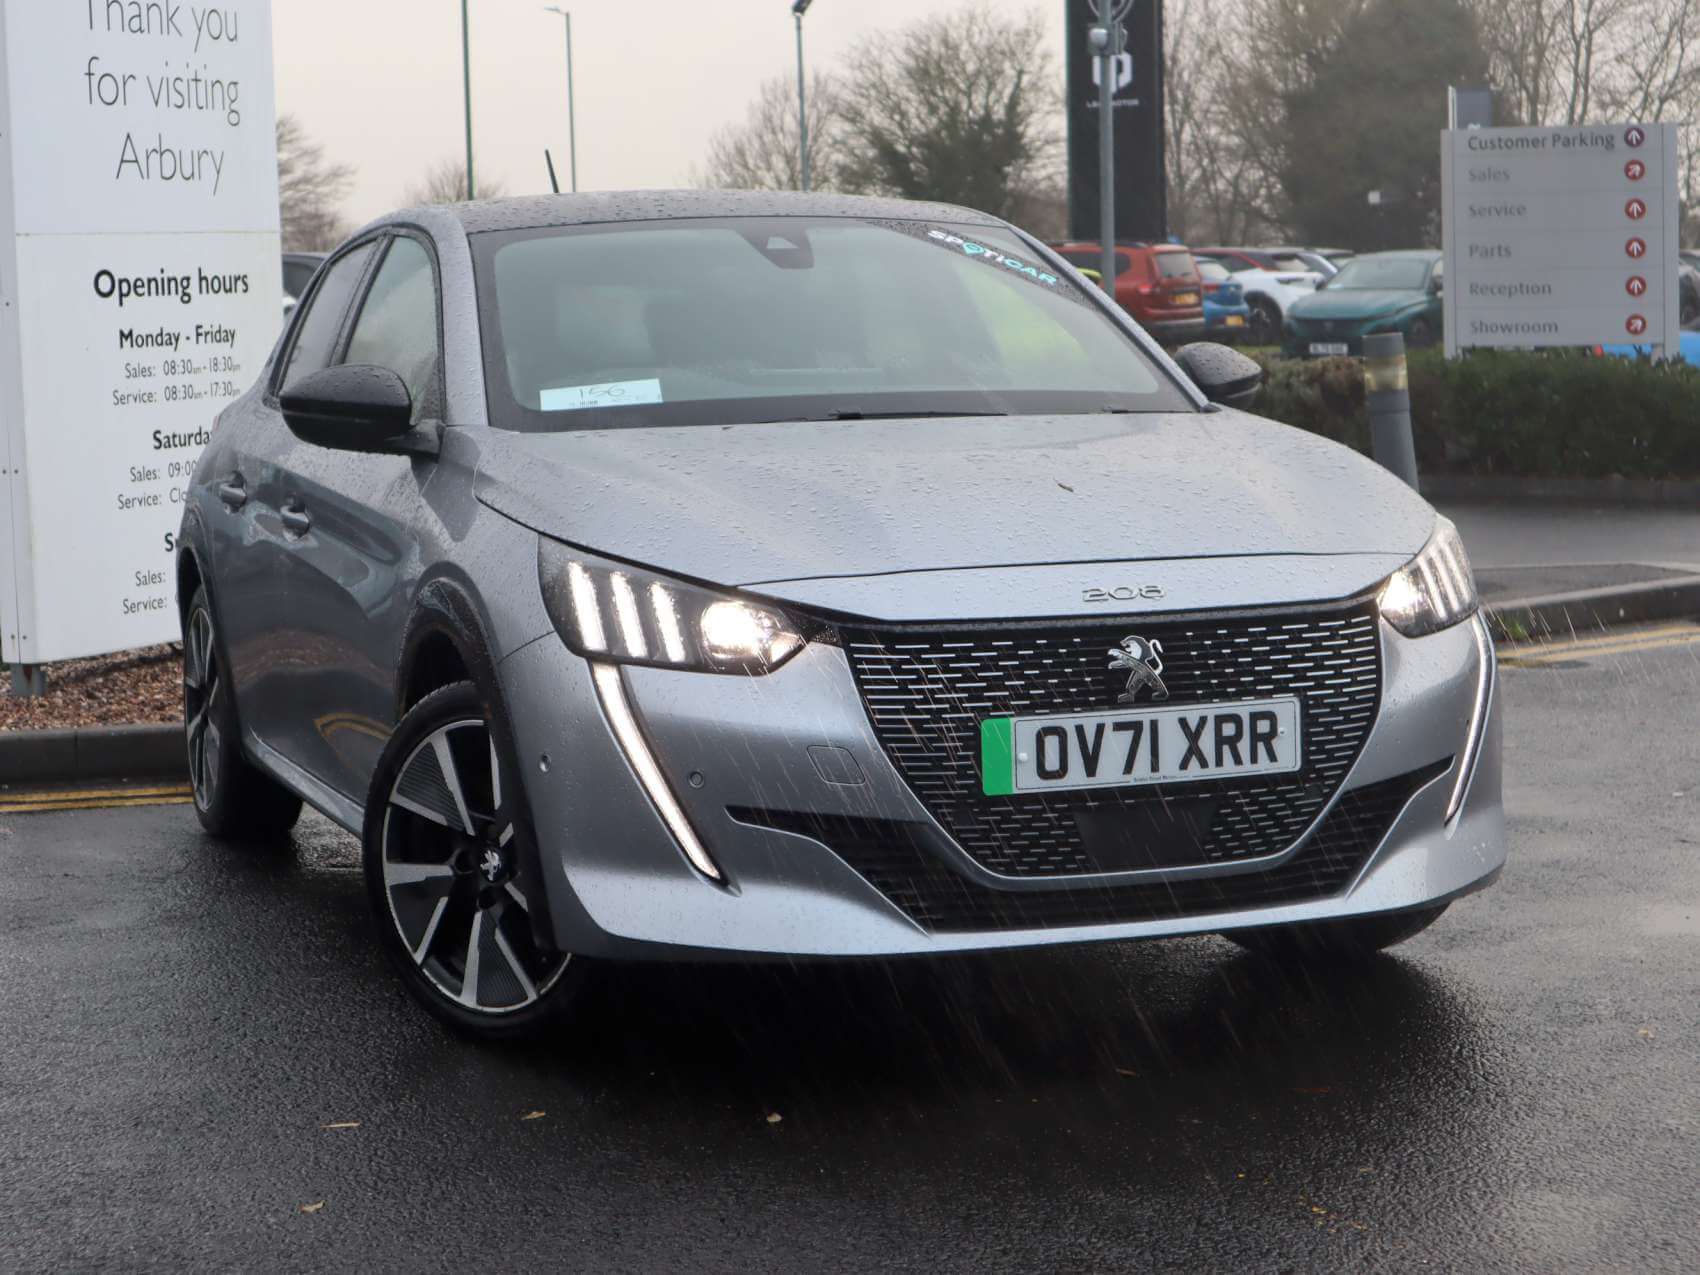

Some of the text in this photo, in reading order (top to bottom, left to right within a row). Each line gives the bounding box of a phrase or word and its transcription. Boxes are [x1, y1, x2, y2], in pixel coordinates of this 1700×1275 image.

[192, 7, 238, 53] you
[84, 56, 240, 127] for visiting
[1468, 131, 1615, 151] Customer Parking
[116, 132, 224, 196] Arbury
[1468, 167, 1510, 182] Sales
[1468, 203, 1526, 218] Service
[1468, 243, 1512, 259] Parts
[93, 267, 249, 307] Opening hours
[1469, 281, 1552, 299] Reception
[1470, 319, 1558, 335] Showroom
[119, 326, 180, 352] Monday
[195, 323, 236, 349] Friday
[124, 361, 156, 379] Sales:
[112, 388, 158, 407] Service:
[152, 426, 211, 450] Saturda
[129, 465, 161, 483] Sales:
[117, 490, 163, 511] Service:
[135, 569, 167, 588] Sales:
[1081, 584, 1166, 603] 208
[122, 595, 168, 616] Service:
[1035, 710, 1279, 782] OV71 XRR
